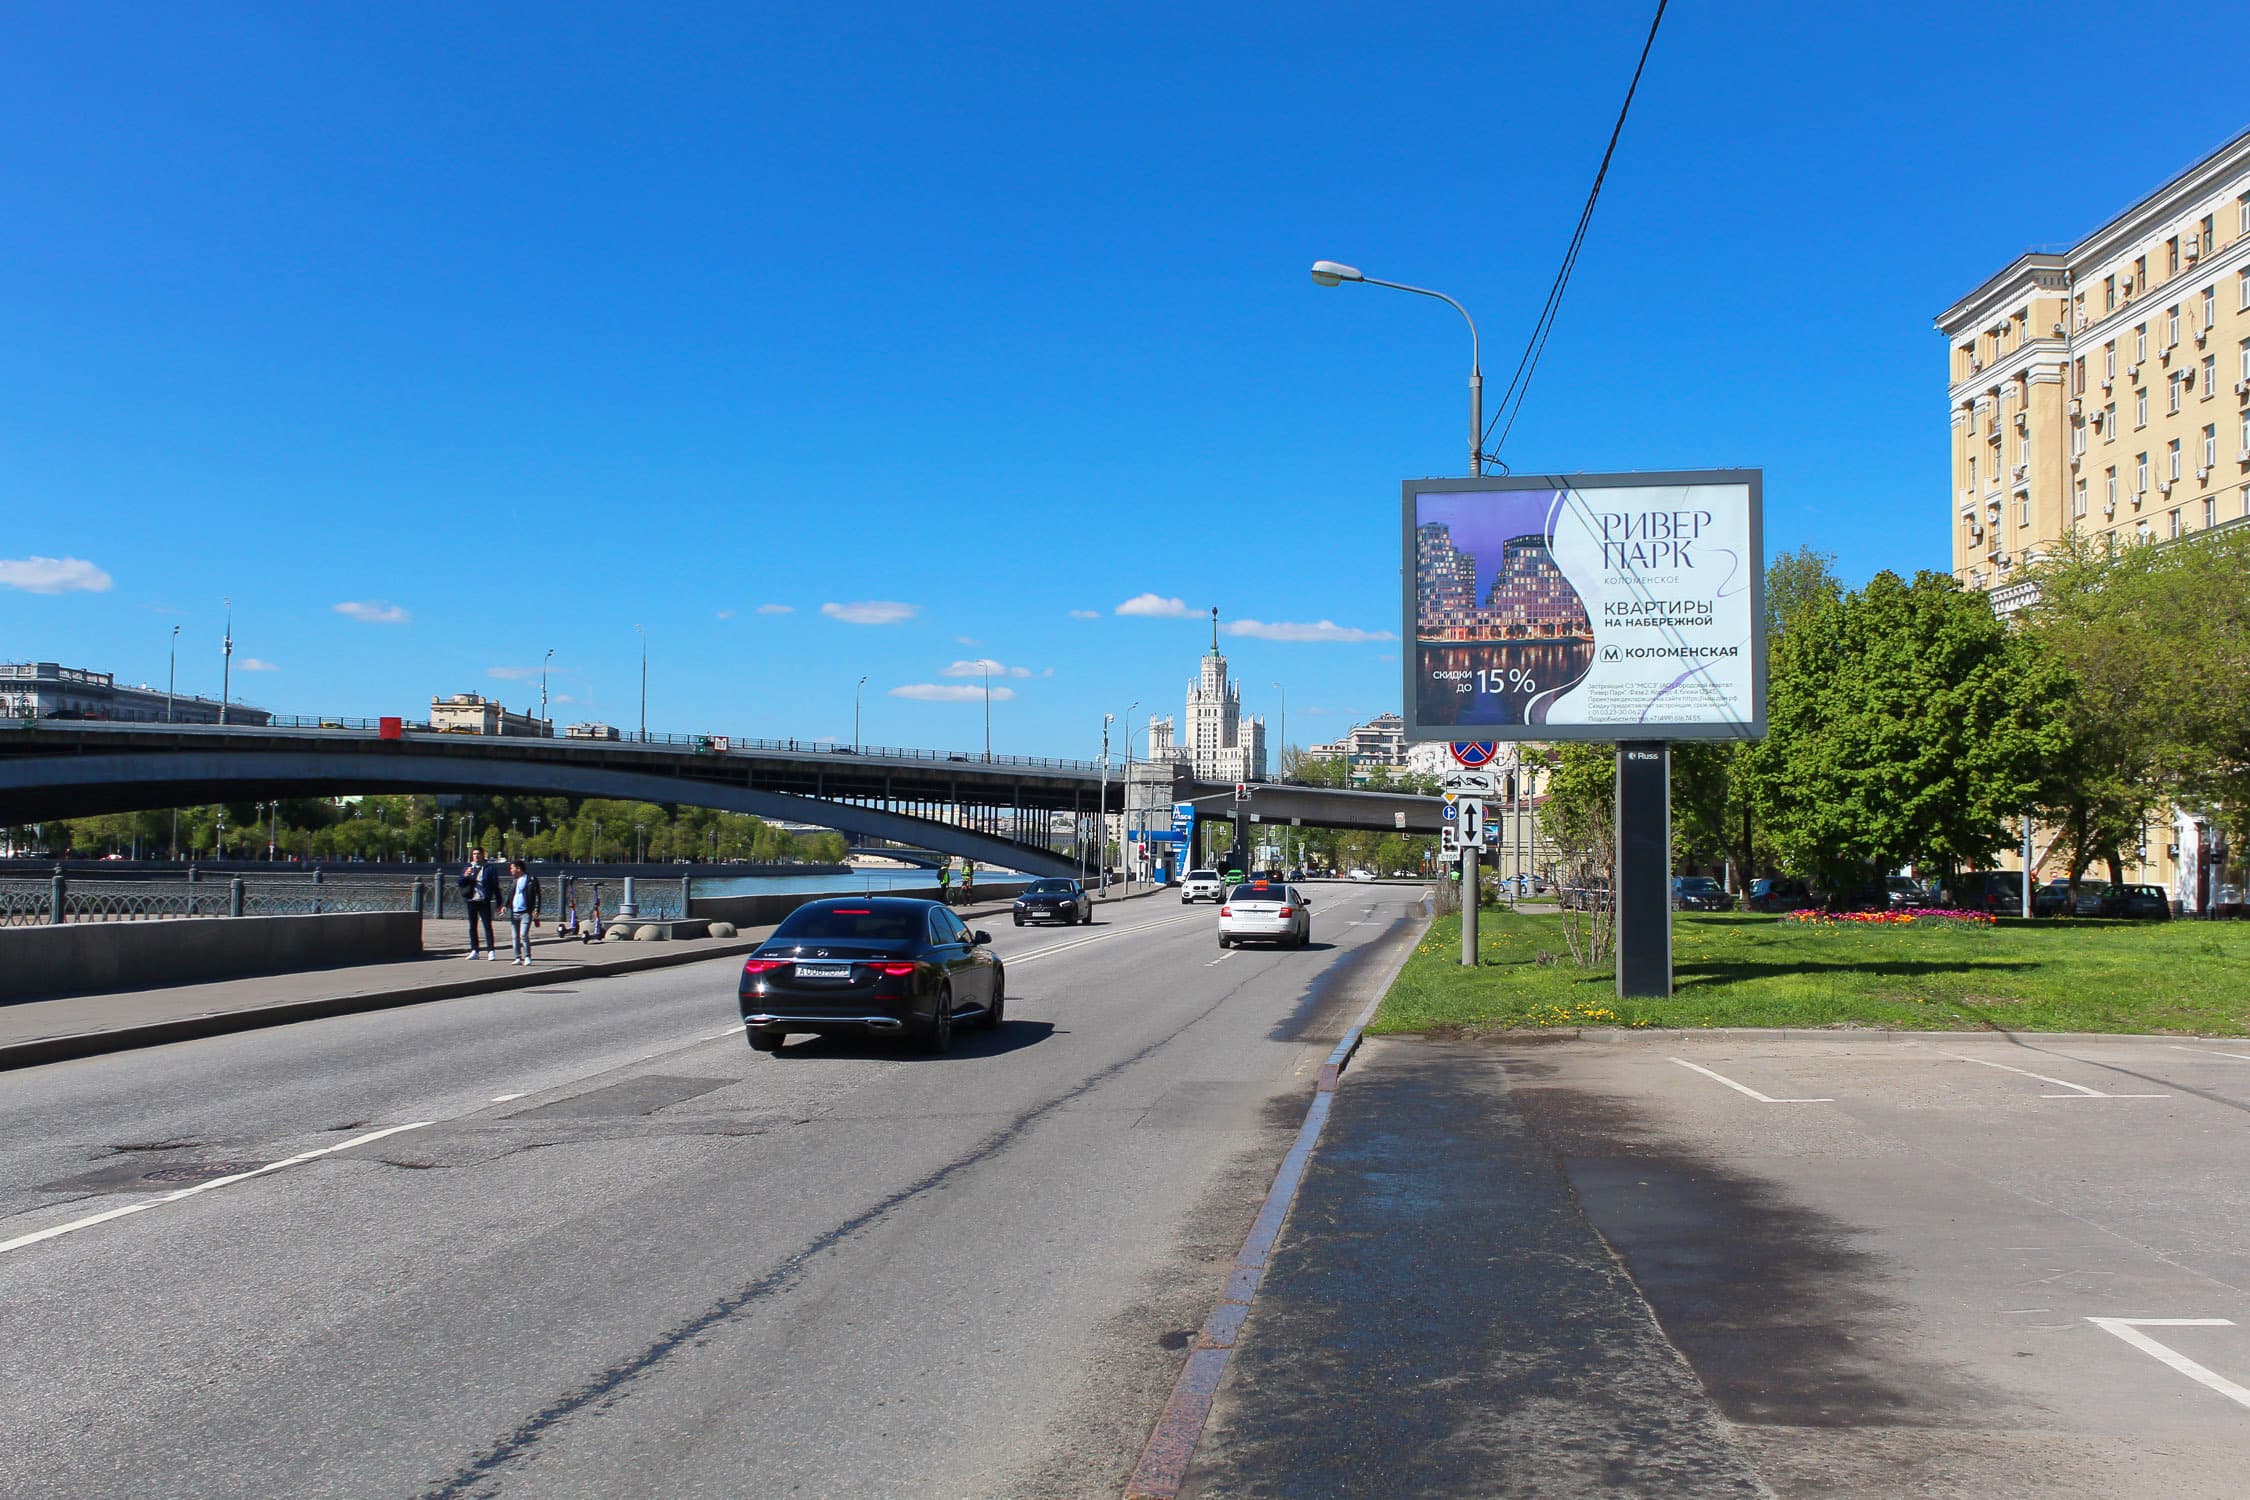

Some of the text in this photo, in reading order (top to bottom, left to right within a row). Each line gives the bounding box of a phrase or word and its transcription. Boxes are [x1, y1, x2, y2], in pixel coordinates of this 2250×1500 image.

[1598, 511, 1711, 540] РИВЕР
[1604, 541, 1694, 569] ПАРК
[1604, 576, 1680, 585] КОЛОМЕНСКОЕ
[1604, 600, 1713, 615] КВАРТИРЫ
[1605, 615, 1713, 627] НА НАБЕРЕЖНОЙ
[1625, 646, 1738, 658] КОЛОМЕНСКАЯ
[1637, 752, 1659, 760] Russ
